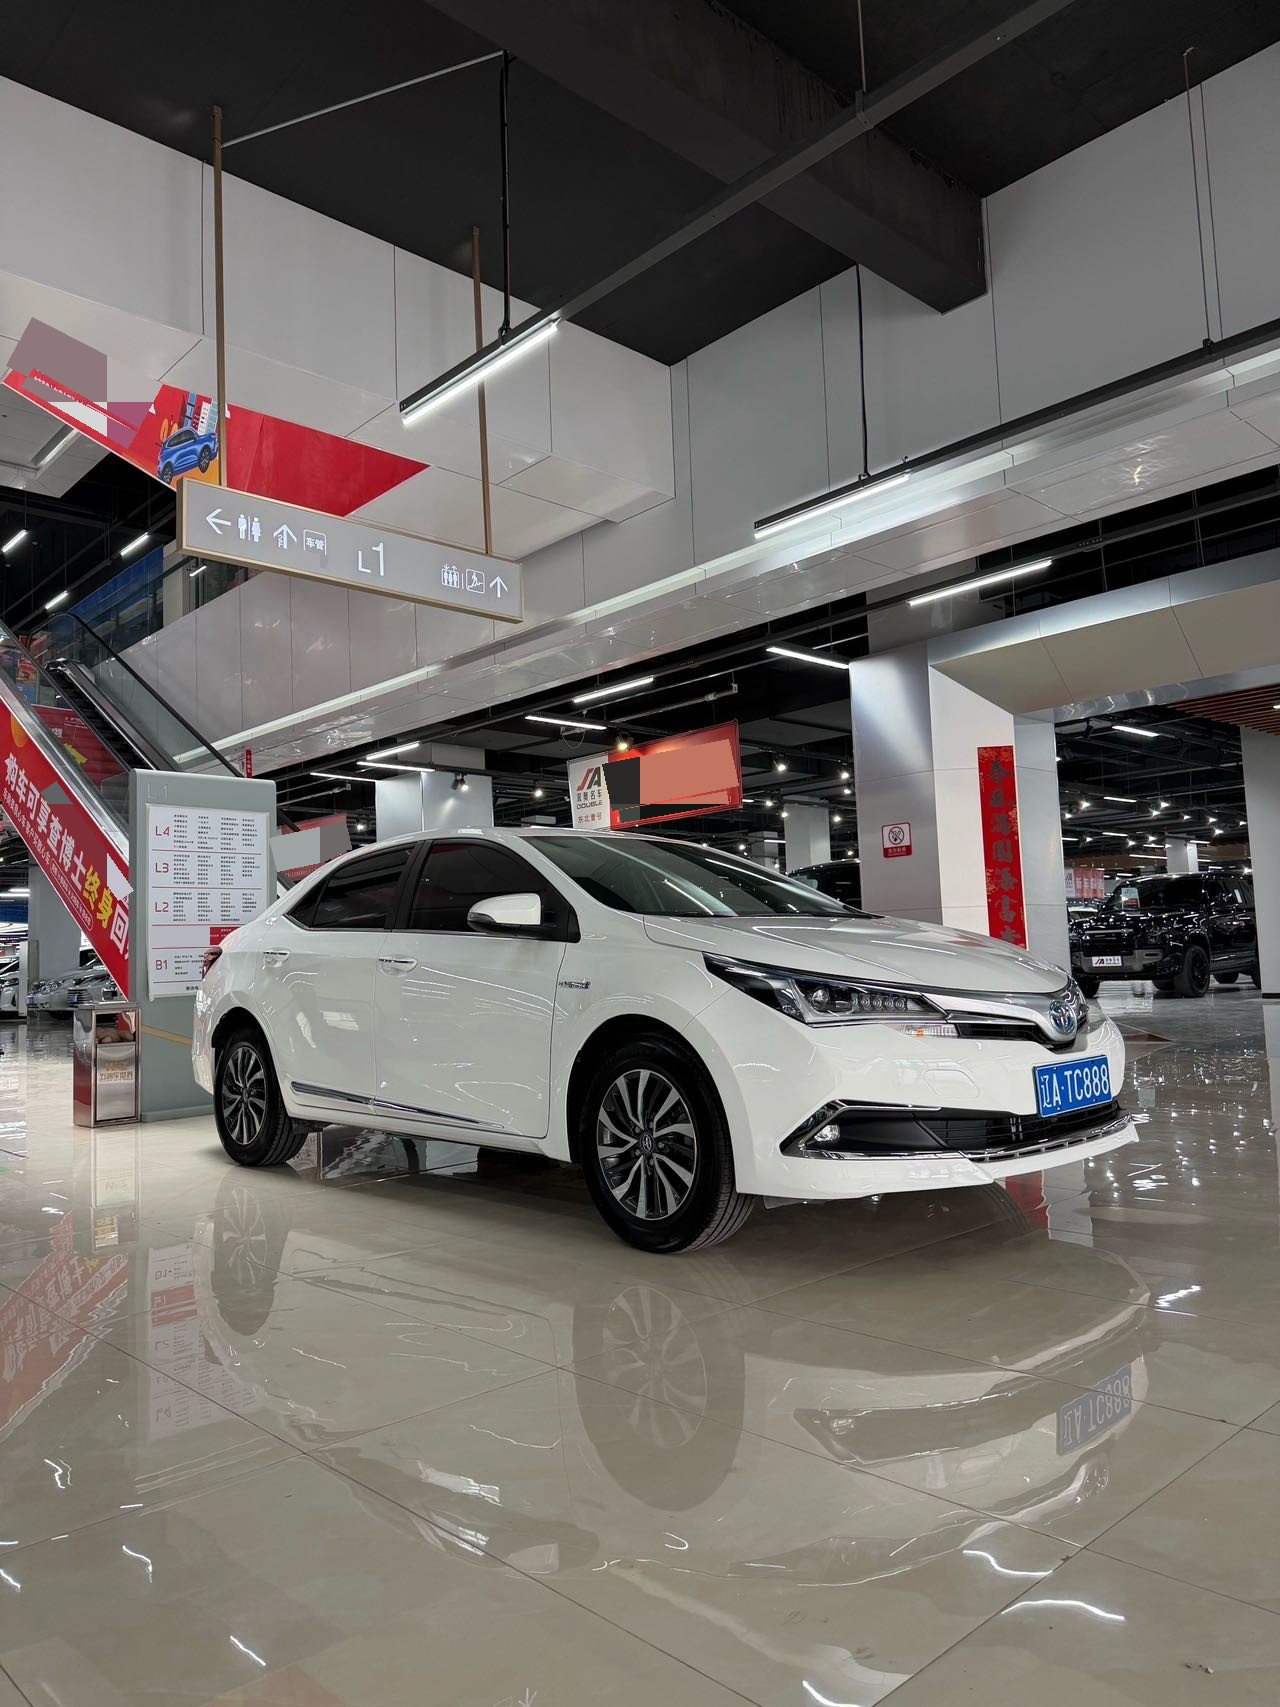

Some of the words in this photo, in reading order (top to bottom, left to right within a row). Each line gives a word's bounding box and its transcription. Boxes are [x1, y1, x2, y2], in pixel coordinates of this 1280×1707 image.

[306, 537, 325, 550] 车管
[358, 542, 385, 577] L1
[155, 825, 170, 837] L4
[4, 752, 129, 960] 购车可享查博士终身回
[155, 862, 170, 874] L3
[154, 901, 169, 913] L2
[155, 959, 168, 971] B1
